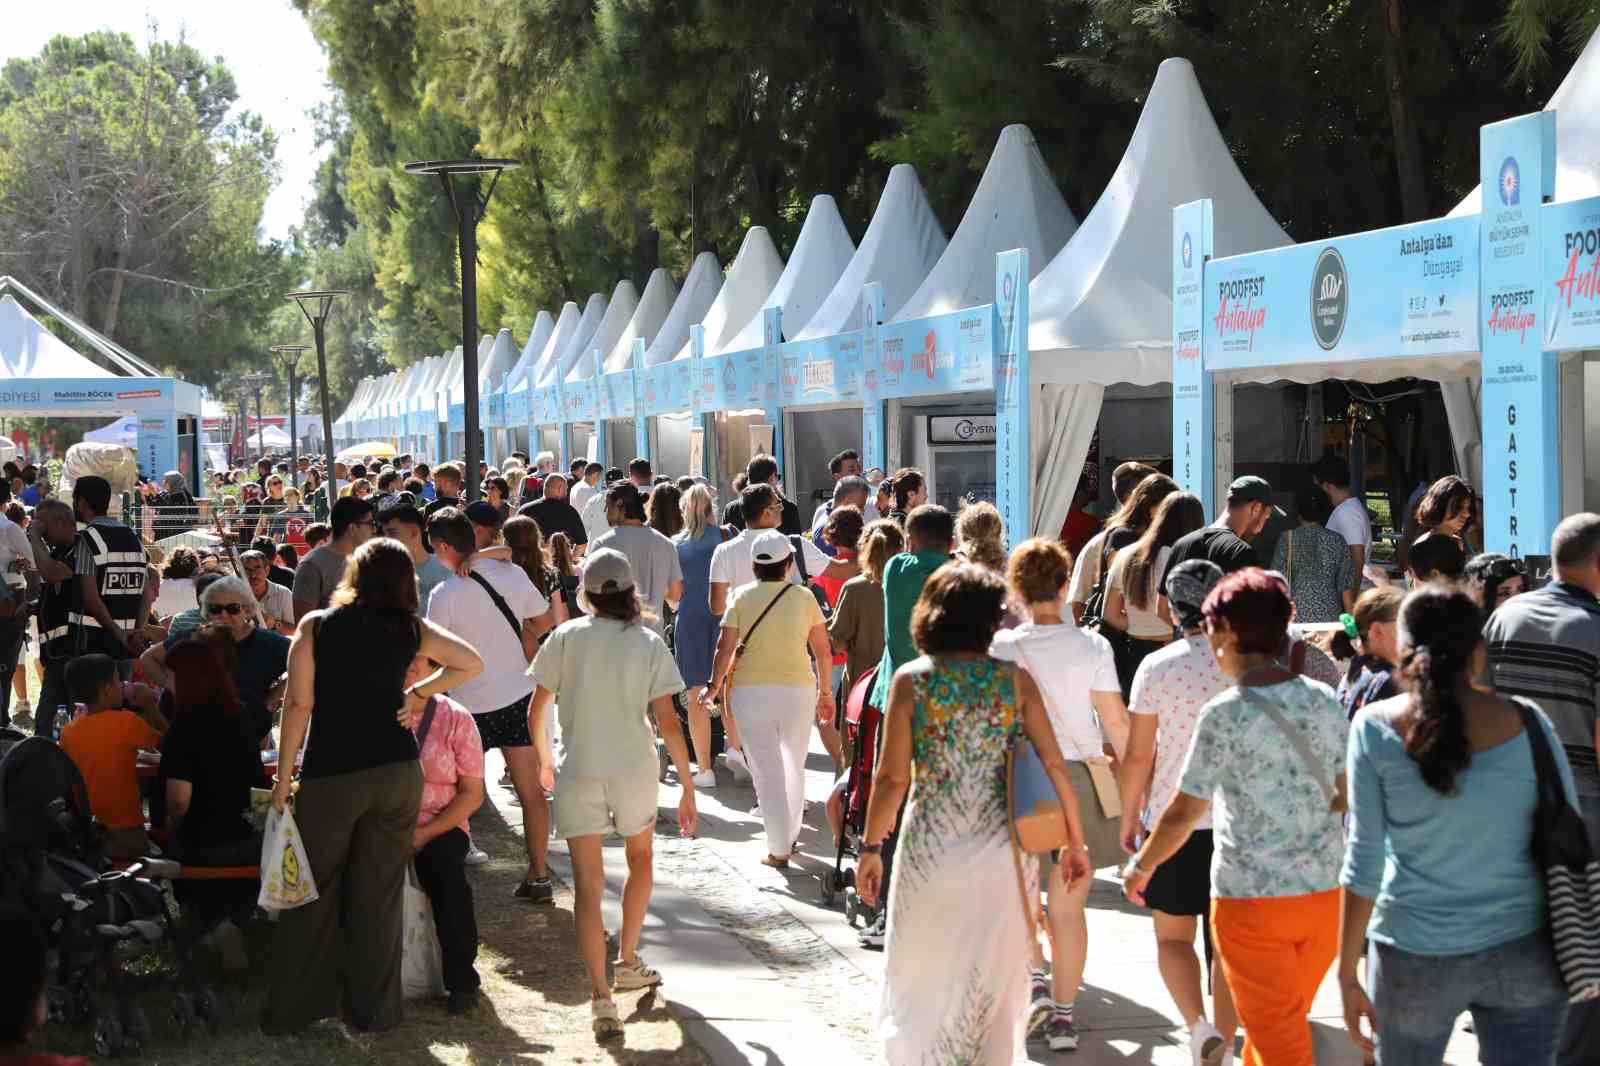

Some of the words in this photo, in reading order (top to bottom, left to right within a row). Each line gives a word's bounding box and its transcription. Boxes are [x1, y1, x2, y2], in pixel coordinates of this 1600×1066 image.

[1400, 233, 1453, 256] Antalya'dan
[1565, 226, 1600, 258] FOO
[1219, 276, 1265, 300] FOODFEST
[1491, 289, 1535, 309] FOODFEST
[1214, 295, 1266, 352] Antalya
[1488, 303, 1536, 345] Antalya
